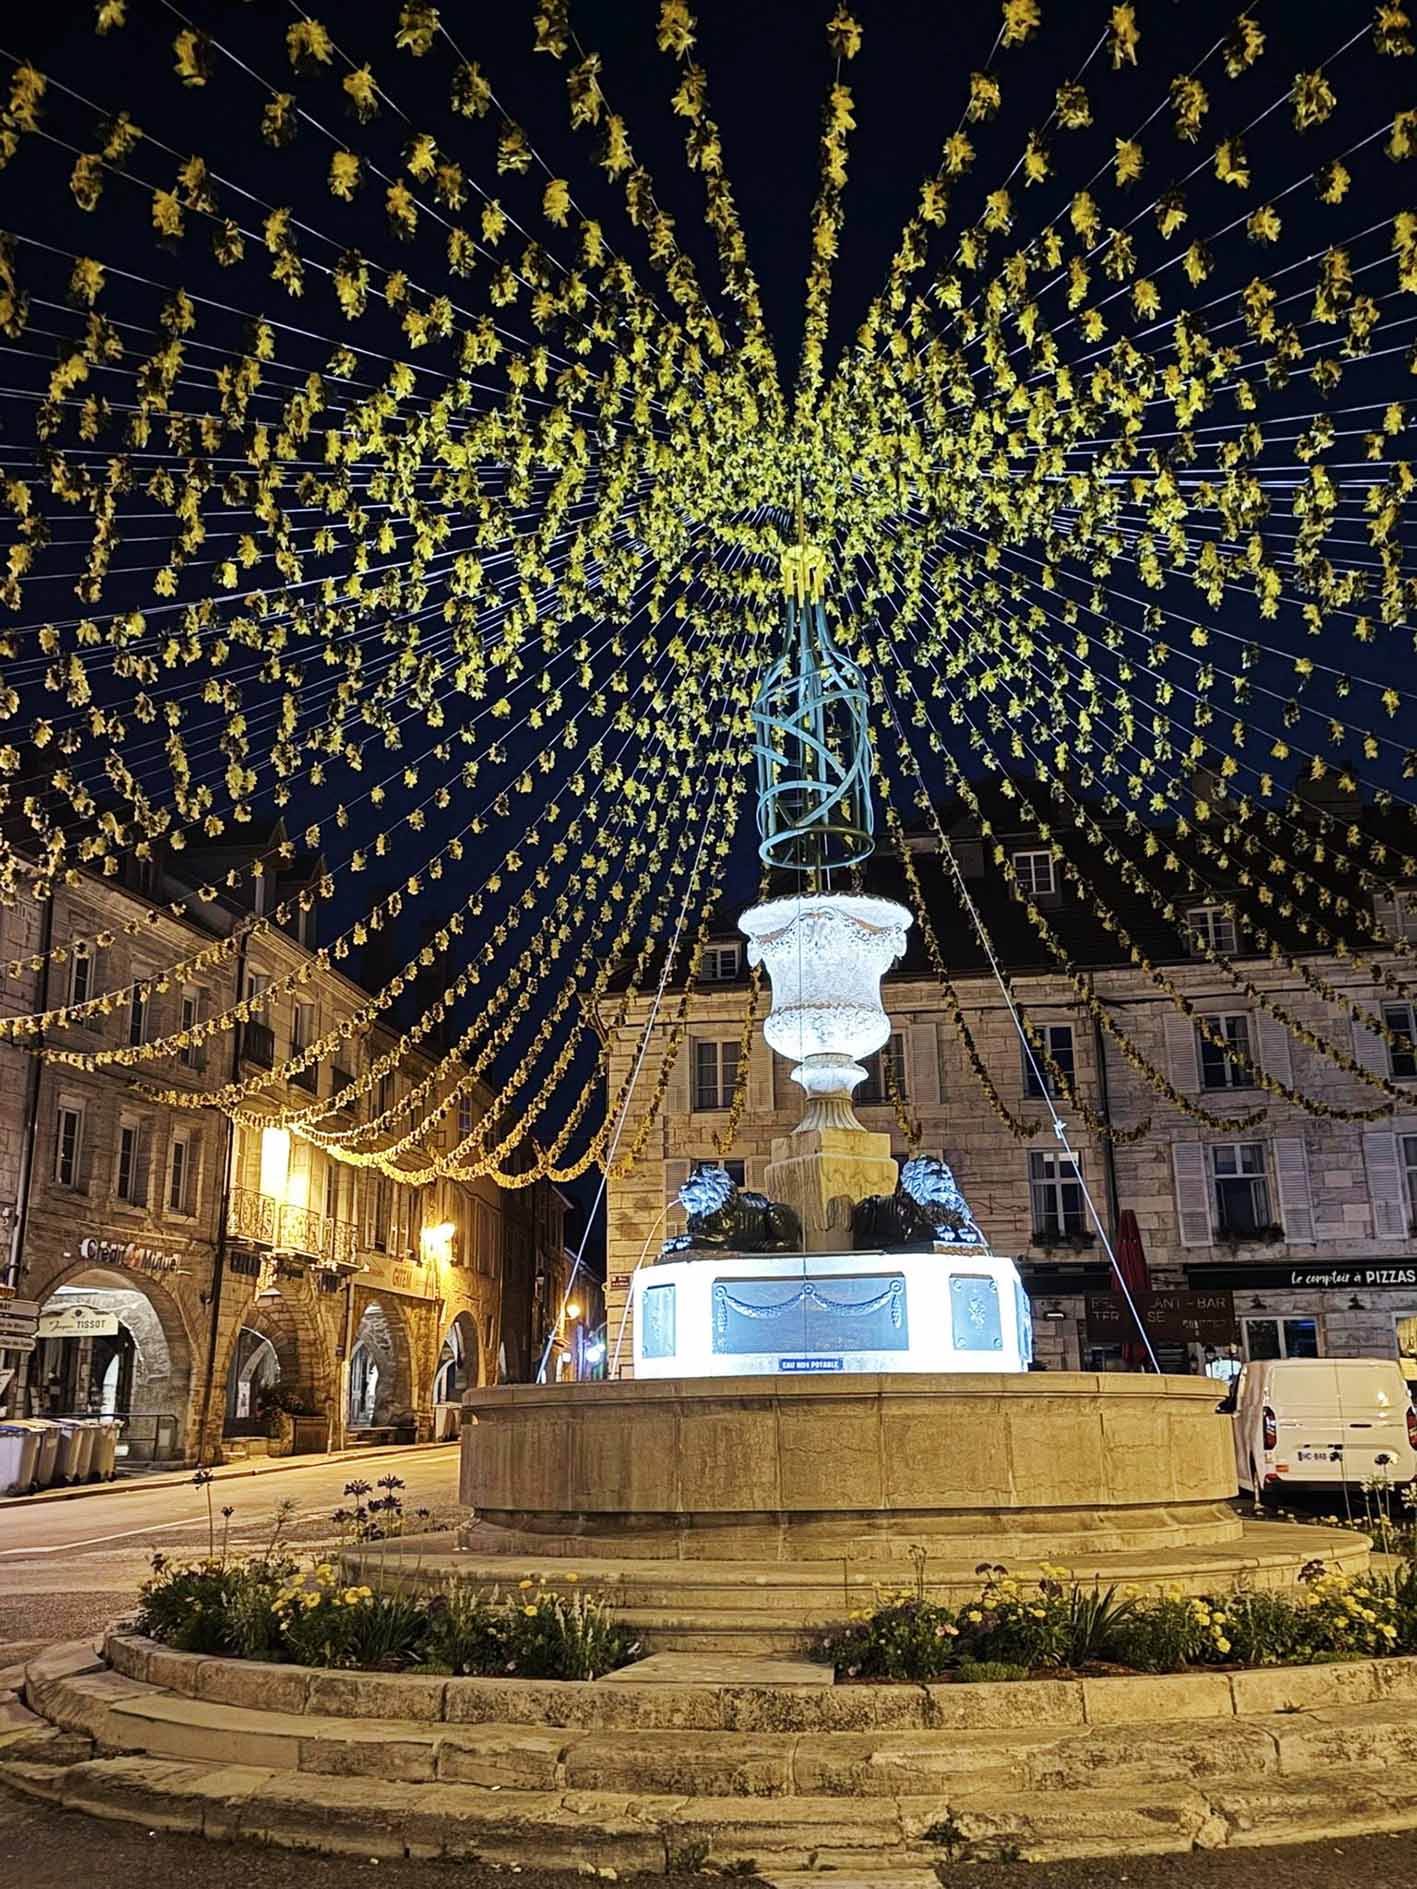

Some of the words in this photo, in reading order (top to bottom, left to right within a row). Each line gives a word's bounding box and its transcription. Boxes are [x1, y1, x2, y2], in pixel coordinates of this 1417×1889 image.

[1291, 1270, 1304, 1285] Le
[1305, 1269, 1351, 1287] comptoir
[1366, 1269, 1417, 1284] PIZZAS
[1197, 1297, 1227, 1310] BAR
[76, 1319, 107, 1330] TISSOT
